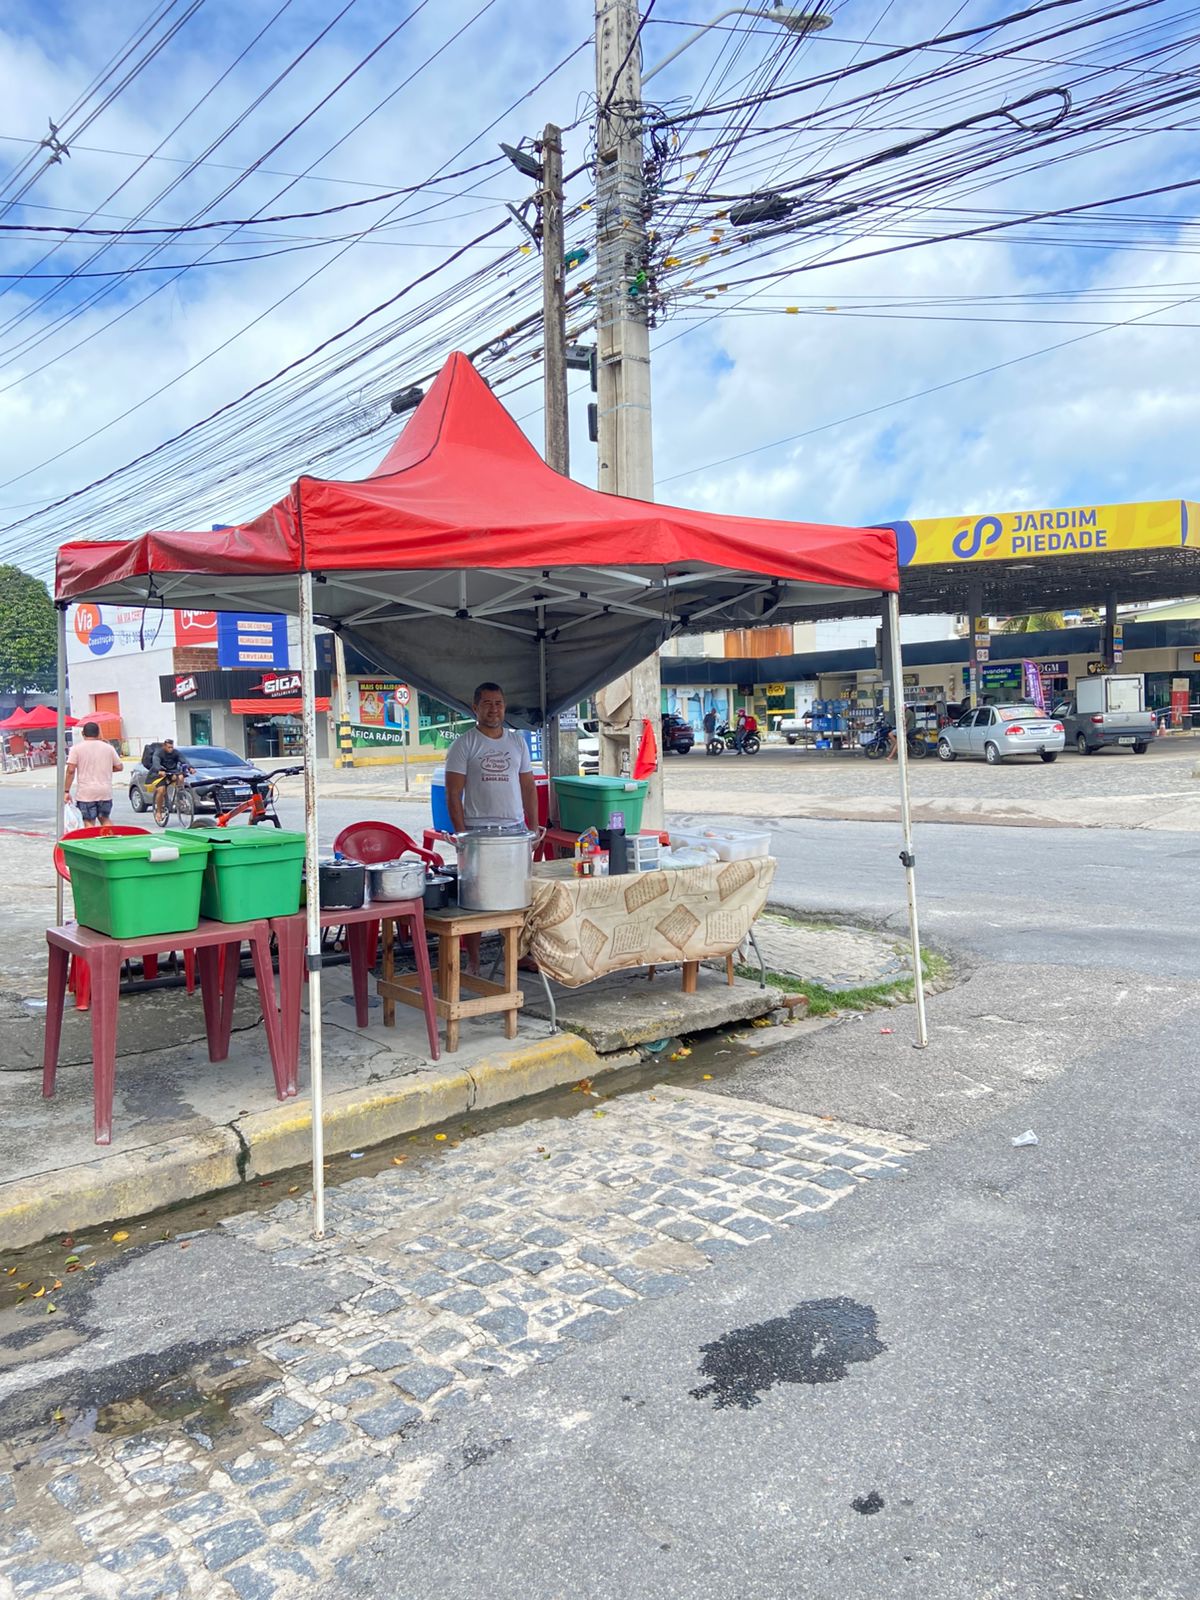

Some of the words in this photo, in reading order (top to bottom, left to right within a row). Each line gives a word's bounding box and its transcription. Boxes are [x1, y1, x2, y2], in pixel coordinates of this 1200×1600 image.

[1011, 509, 1097, 533] JARDIM
[1011, 530, 1107, 553] PIEDADE
[77, 608, 93, 632] Via
[89, 634, 114, 647] Construção
[982, 667, 1012, 675] avanderia
[264, 675, 301, 693] GIGA
[360, 683, 374, 691] MAIS
[398, 690, 408, 699] 30
[350, 729, 375, 740] ÁFICA
